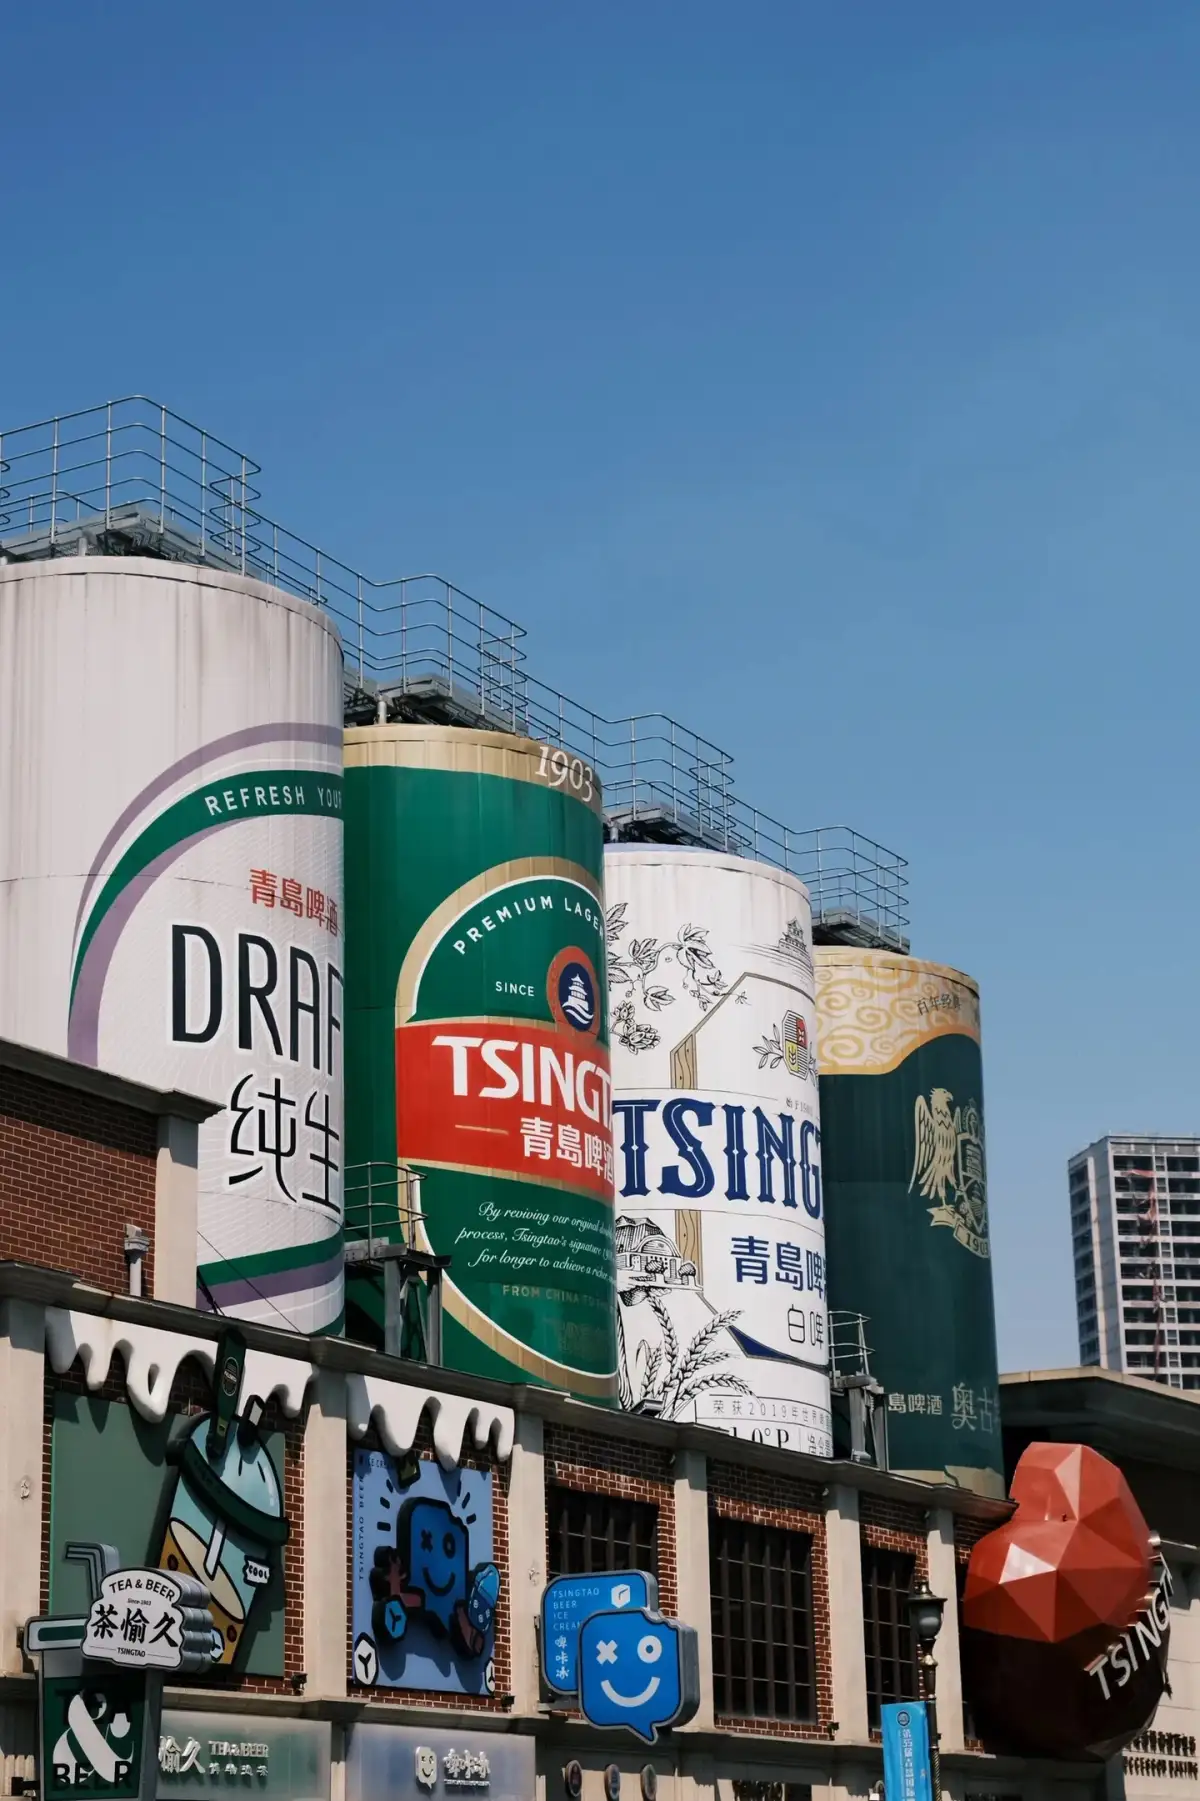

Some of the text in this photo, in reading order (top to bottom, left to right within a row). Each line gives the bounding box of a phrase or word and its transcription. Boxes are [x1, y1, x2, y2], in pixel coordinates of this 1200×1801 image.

[535, 746, 593, 802] 1903
[205, 785, 305, 816] REFRESH
[249, 868, 338, 938] 青島啤酒
[453, 895, 554, 955] PREMIUM
[172, 924, 344, 1076] DRAF
[495, 981, 535, 997] SINCE
[229, 1073, 341, 1214] 纯生
[519, 1117, 613, 1185] 青島啤酒
[478, 1201, 502, 1222] By
[504, 1207, 550, 1226] reviving
[552, 1215, 570, 1224] our
[571, 1217, 600, 1232] original
[454, 1227, 508, 1245] process,
[511, 1227, 567, 1248] Tsingtao's
[467, 1248, 497, 1268] for
[499, 1249, 538, 1269] longer
[538, 1256, 550, 1267] to
[552, 1257, 586, 1273] achieve
[730, 1236, 827, 1299] 青島啤
[502, 1285, 540, 1297] FROM
[545, 1288, 580, 1304] CHINA
[787, 1303, 824, 1350] 白啤
[872, 1393, 942, 1415] 島啤酒
[249, 1565, 267, 1579] COOL
[109, 1578, 175, 1601] TEA & BEER
[552, 1587, 600, 1598] TSINGTAO
[553, 1600, 578, 1609] BEER
[553, 1611, 569, 1620] ICE
[91, 1604, 178, 1648] 茶愉久
[117, 1647, 146, 1657] TSINGTAO
